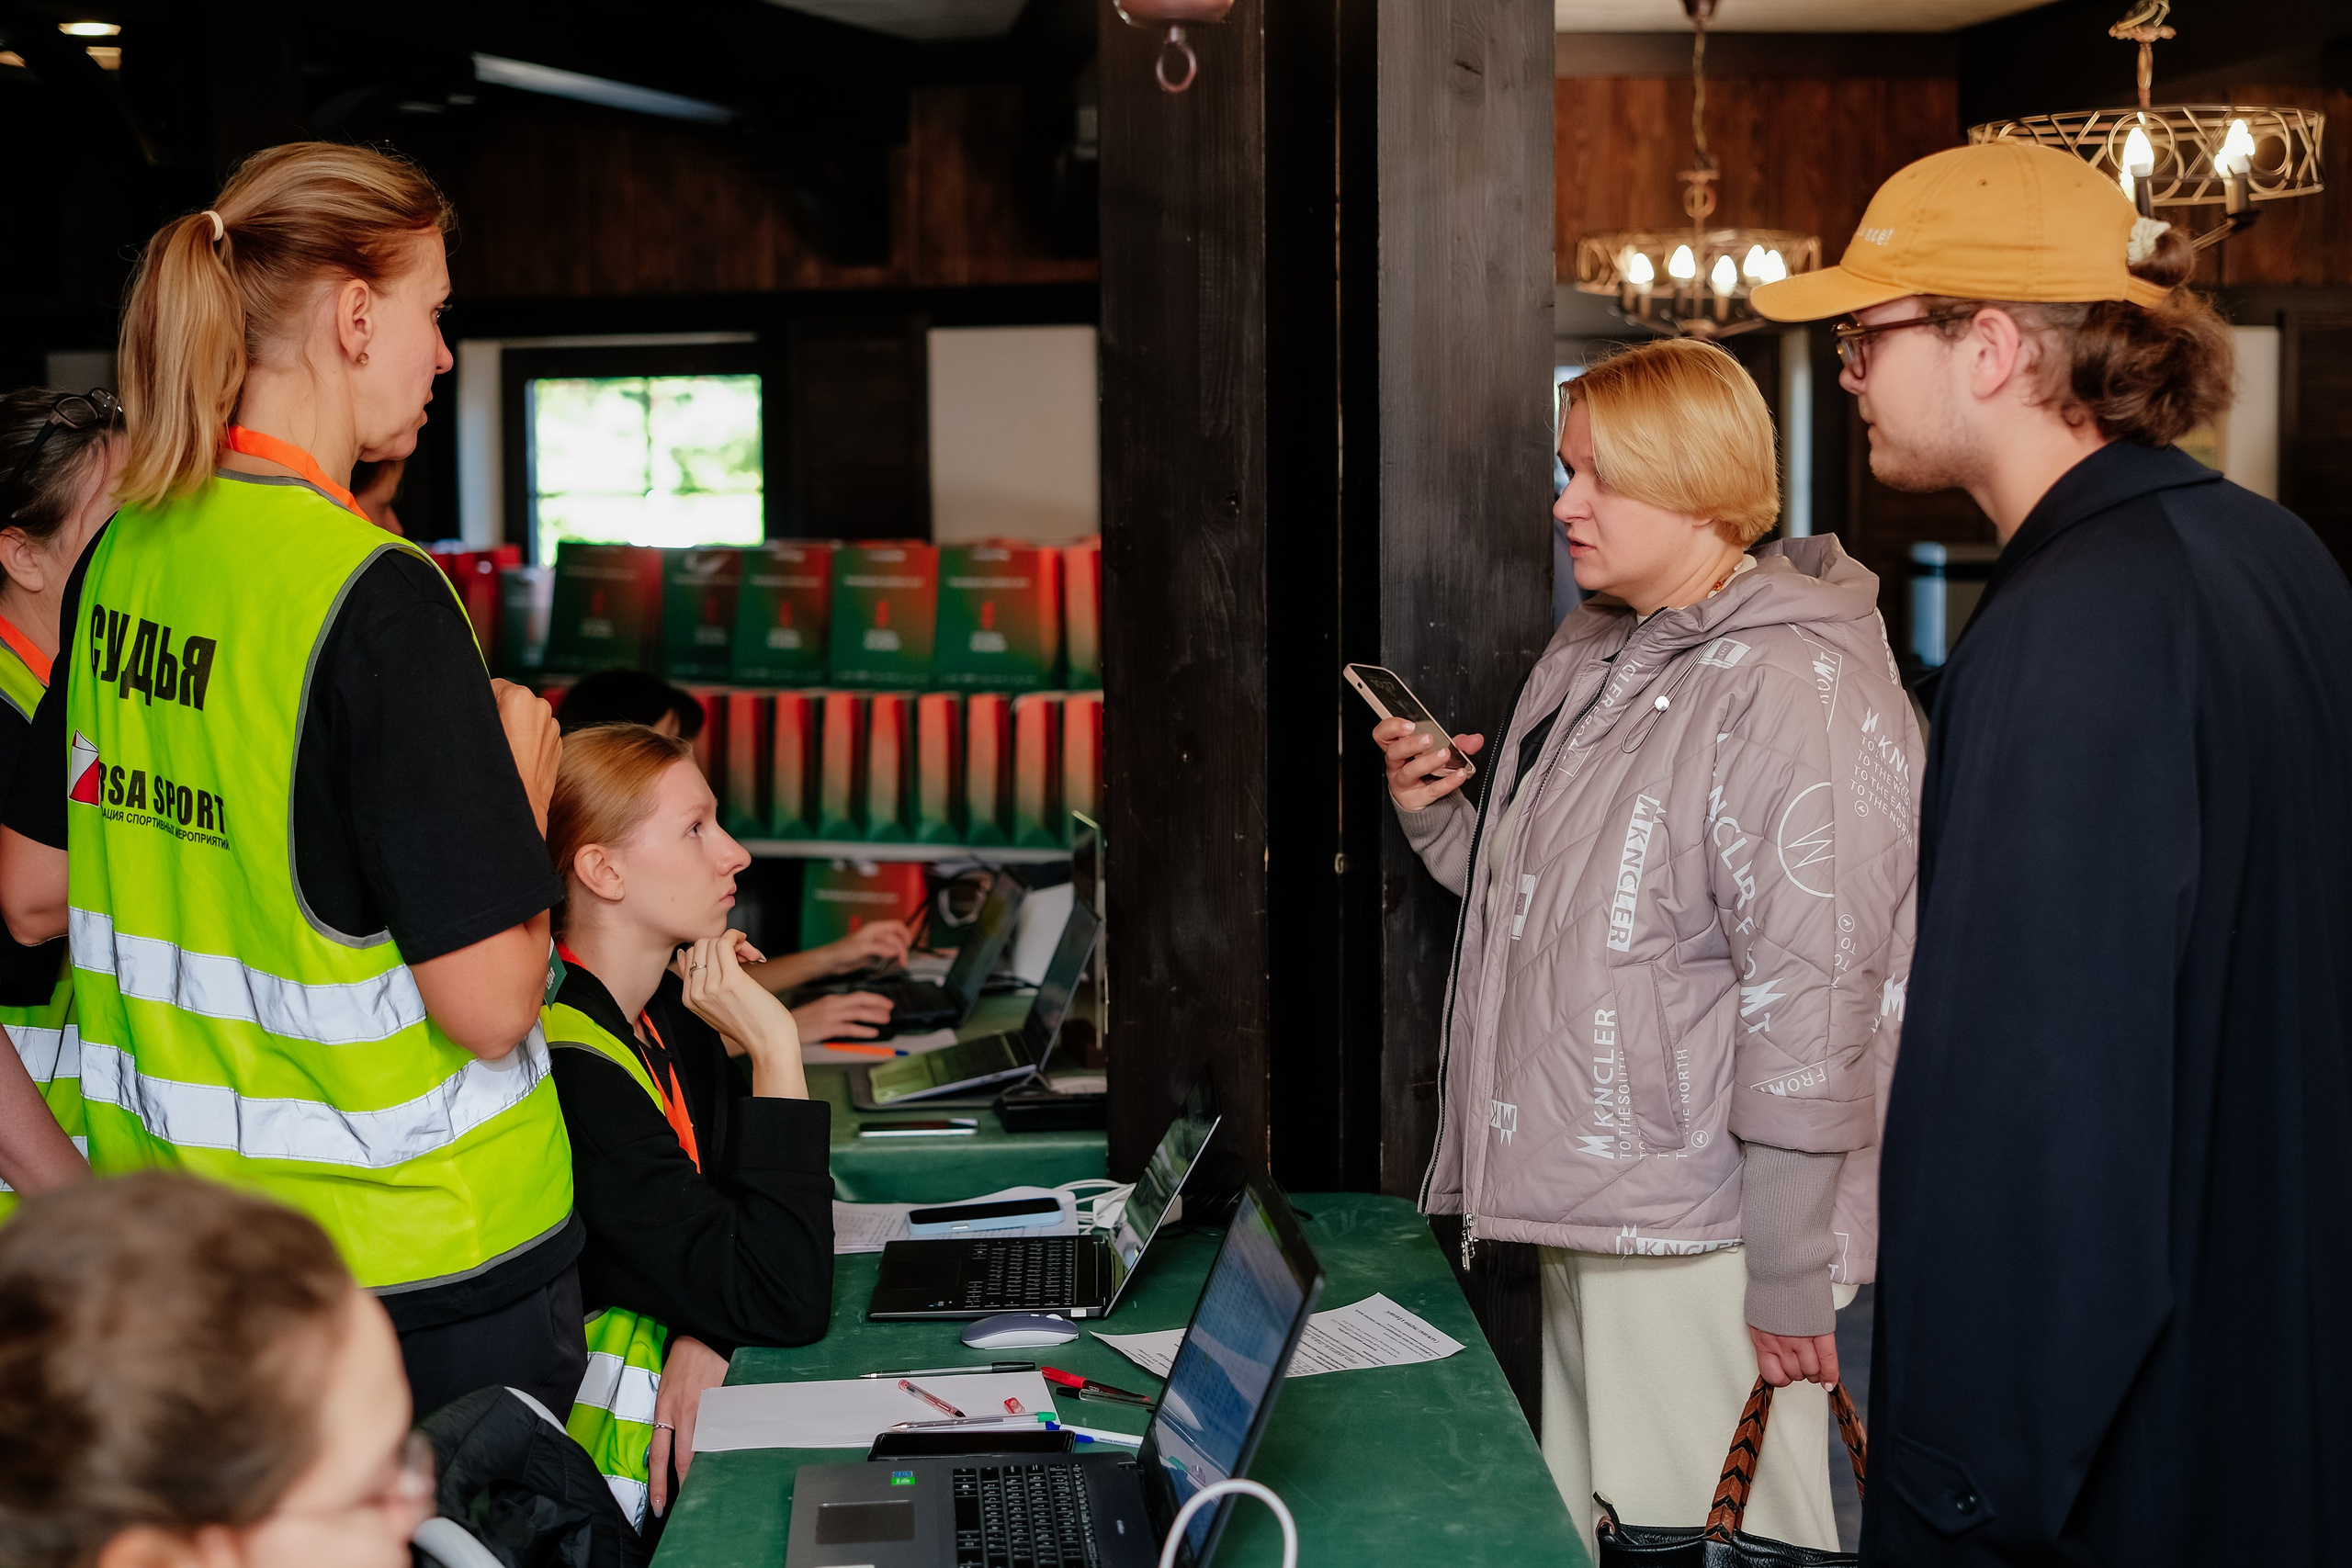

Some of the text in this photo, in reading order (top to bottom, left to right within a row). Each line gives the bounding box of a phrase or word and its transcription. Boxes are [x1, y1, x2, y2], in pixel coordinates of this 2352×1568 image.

[90, 604, 217, 712] СУДЬЯ
[153, 775, 226, 835] SPORT
[1849, 779, 1865, 796] TO
[1577, 1009, 1616, 1160] MKNCLER
